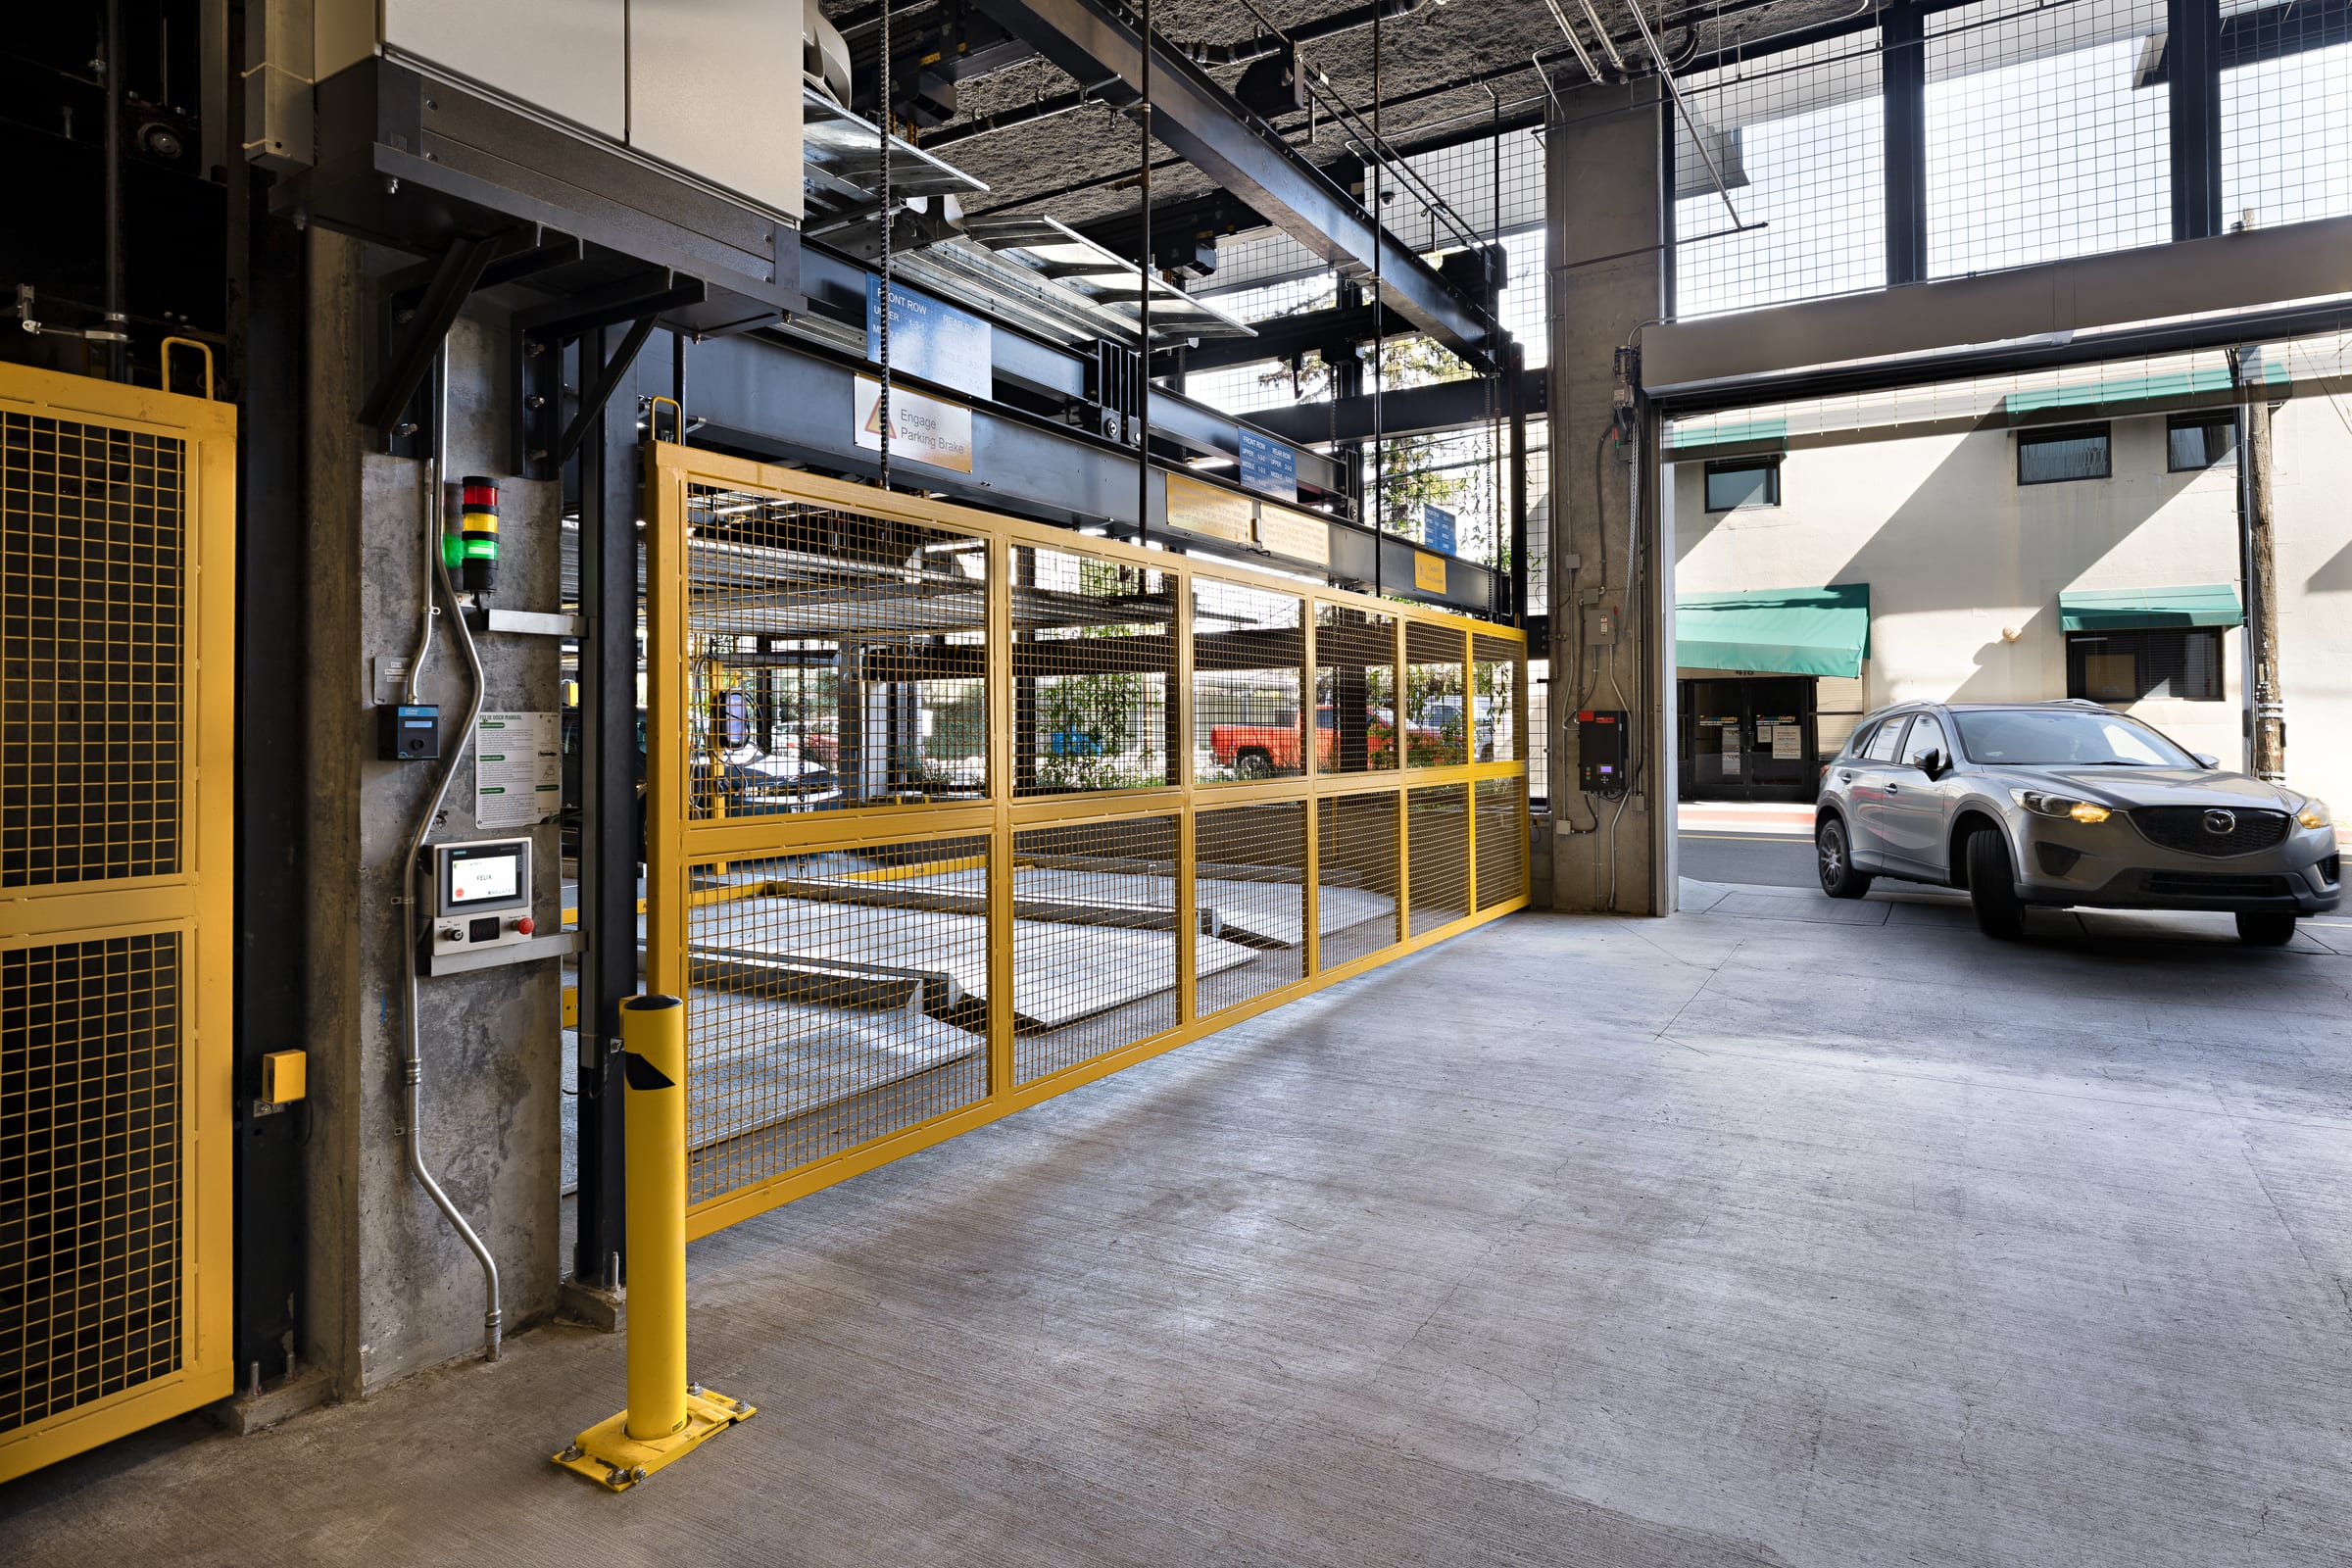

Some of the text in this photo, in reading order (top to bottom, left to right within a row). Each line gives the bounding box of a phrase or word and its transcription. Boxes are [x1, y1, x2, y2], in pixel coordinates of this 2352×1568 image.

[877, 287, 927, 316] FONT ROW
[873, 305, 900, 322] UER
[901, 409, 937, 430] Engage
[901, 426, 964, 455] Parking Brake
[1243, 435, 1266, 451] FRONT ROW
